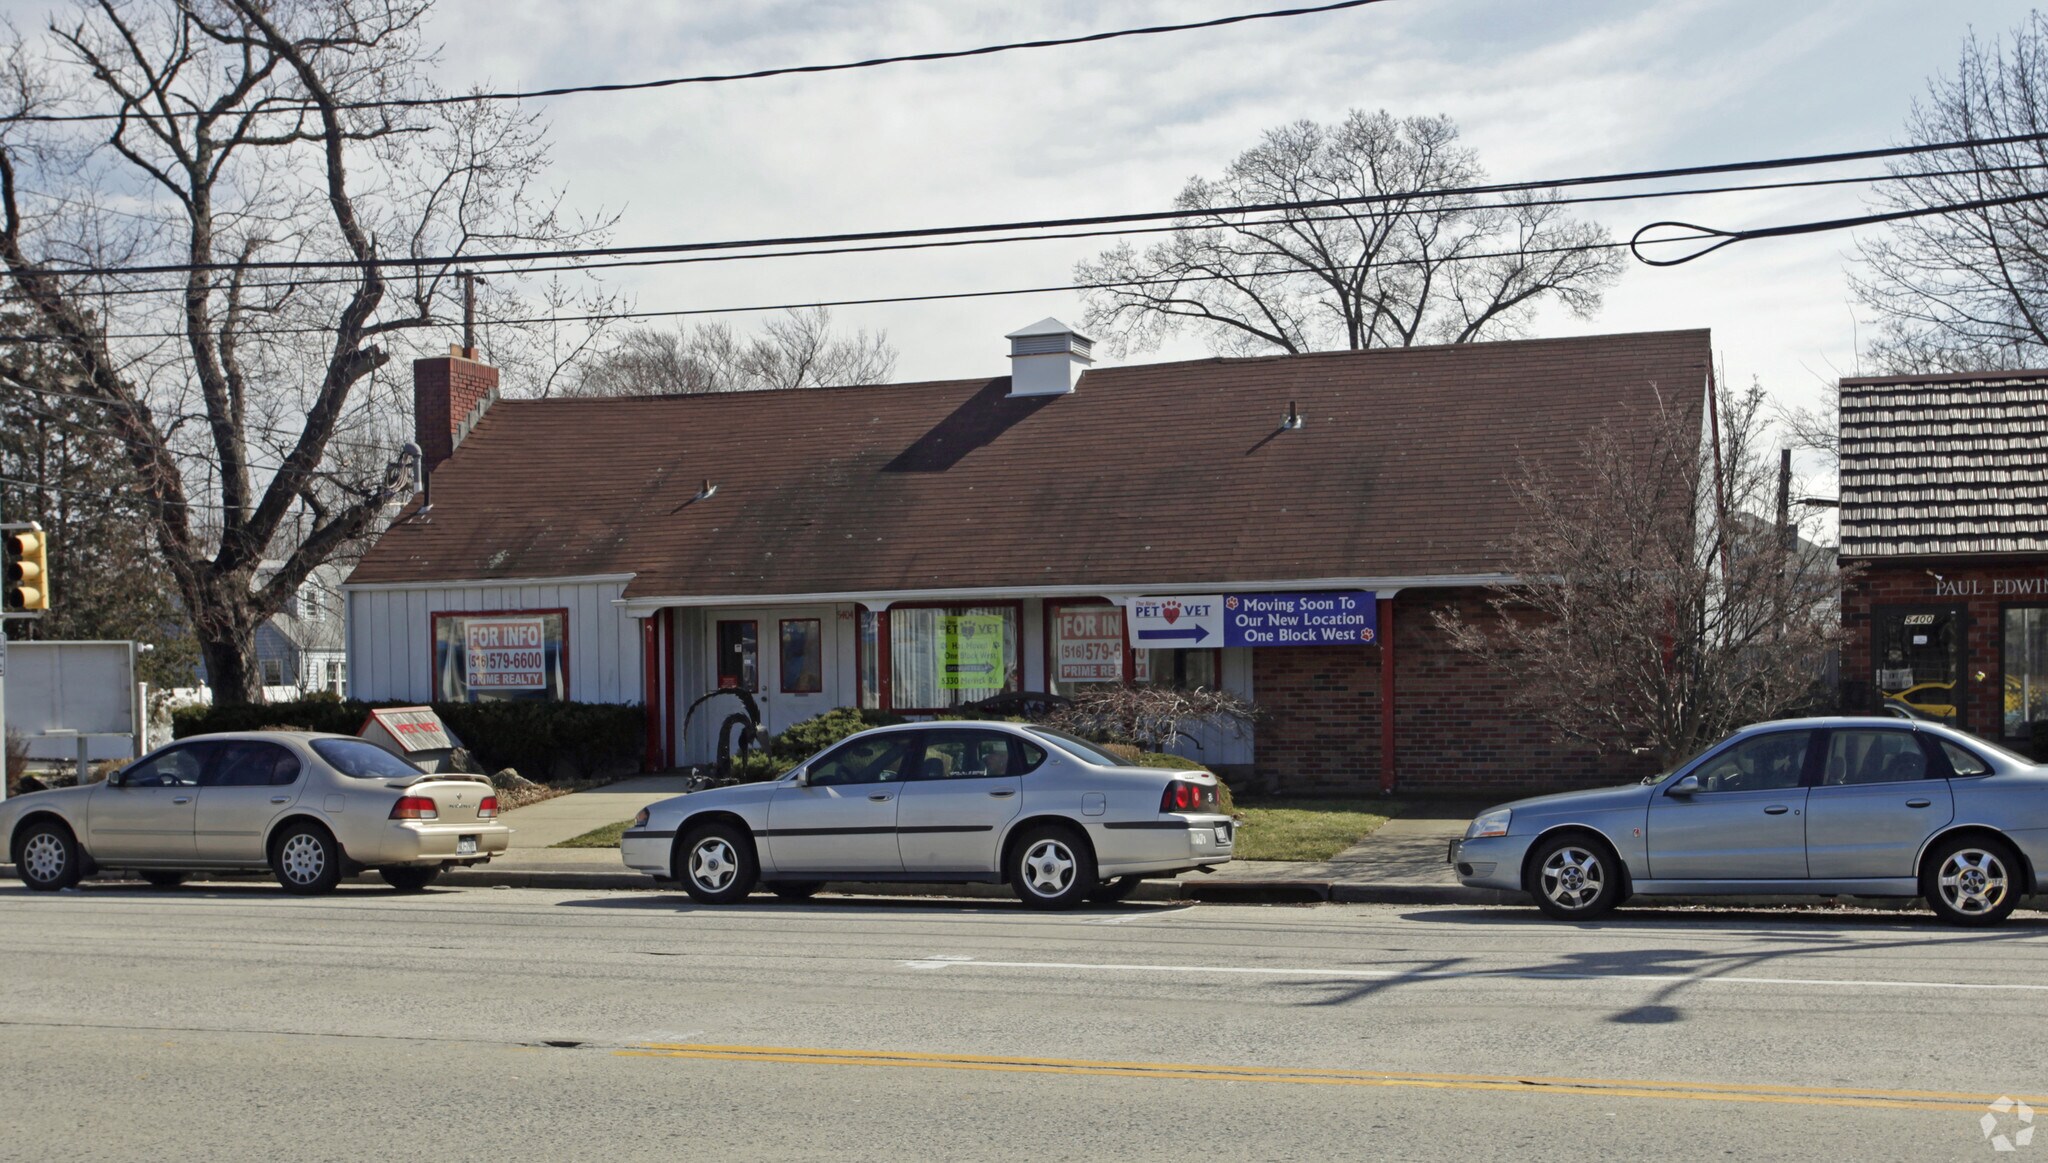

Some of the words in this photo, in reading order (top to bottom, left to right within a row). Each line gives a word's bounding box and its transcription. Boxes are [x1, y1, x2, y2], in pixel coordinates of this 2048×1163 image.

[1935, 579, 1983, 596] PAUL
[1136, 606, 1160, 617] PET
[1184, 605, 1211, 616] VET
[1243, 598, 1295, 613] Moving
[1300, 597, 1334, 610] Soon
[1338, 596, 1356, 609] To
[1063, 615, 1097, 637] FOR
[1235, 614, 1263, 627] Our
[1268, 613, 1299, 626] New
[1304, 612, 1364, 625] Location
[1905, 615, 1933, 624] 5400
[469, 626, 499, 647] FOR
[503, 625, 539, 647] INFO
[978, 624, 999, 634] VET
[1244, 628, 1274, 642] One
[1279, 628, 1317, 641] Block
[1321, 627, 1356, 640] West
[1063, 665, 1097, 677] PRIME
[470, 674, 500, 685] PRIME
[502, 673, 540, 685] REALTY
